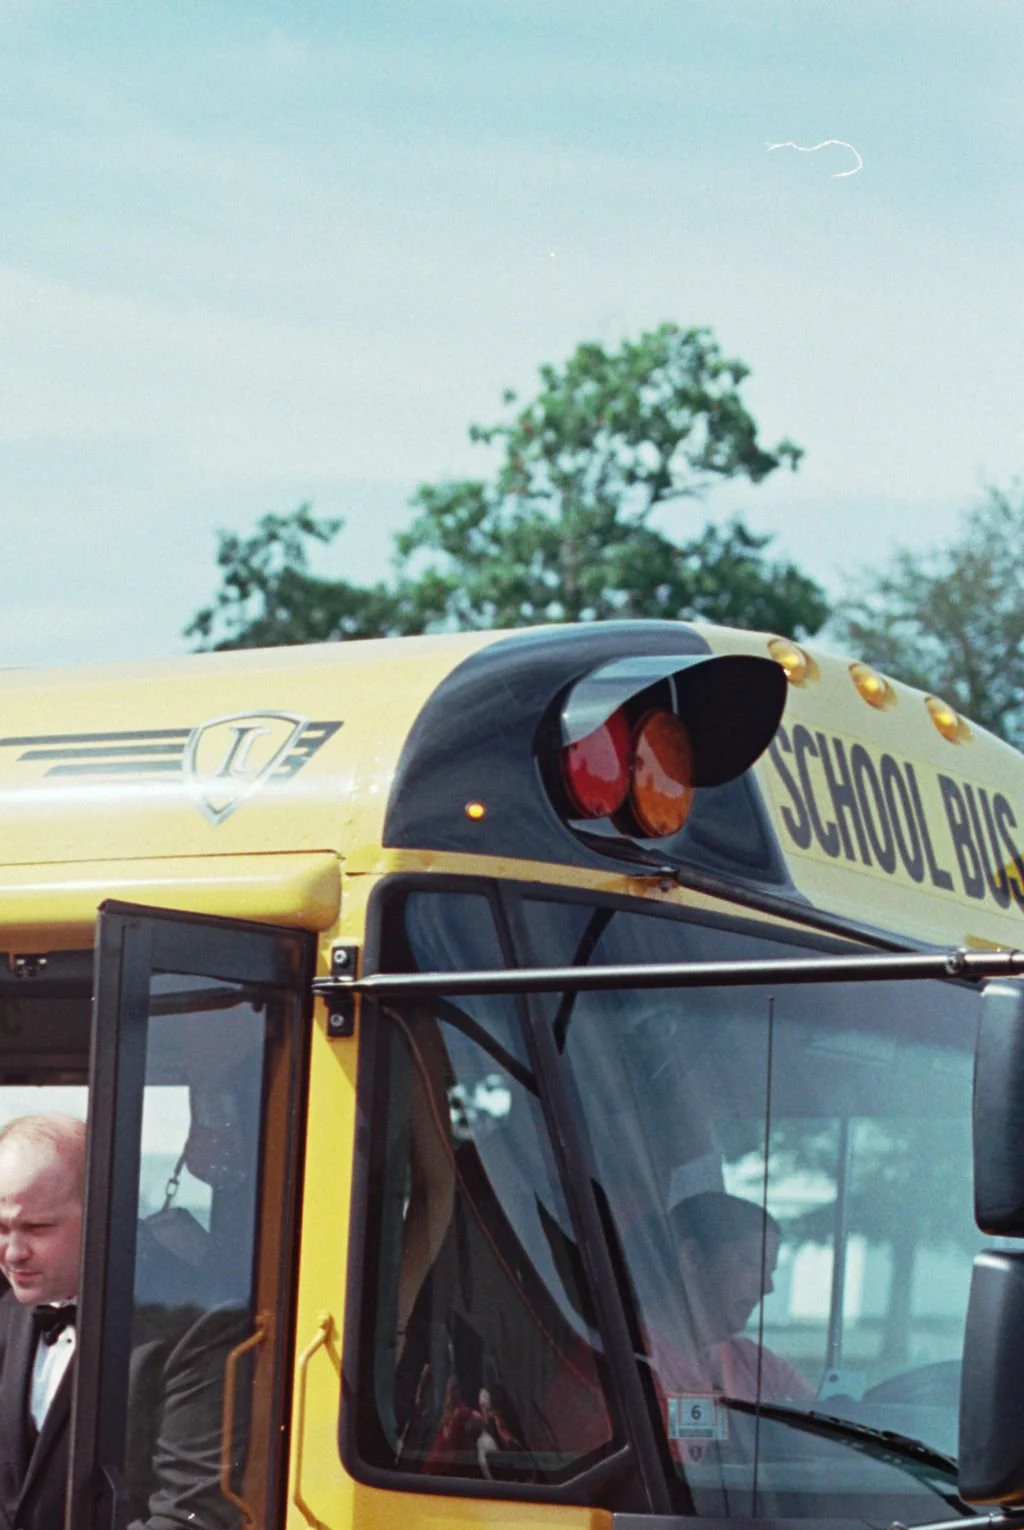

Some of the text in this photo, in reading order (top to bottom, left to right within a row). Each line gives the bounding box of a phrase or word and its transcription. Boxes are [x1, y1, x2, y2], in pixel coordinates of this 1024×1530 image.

[768, 723, 1024, 914] SCHOOL BUS
[691, 1404, 702, 1420] 6
